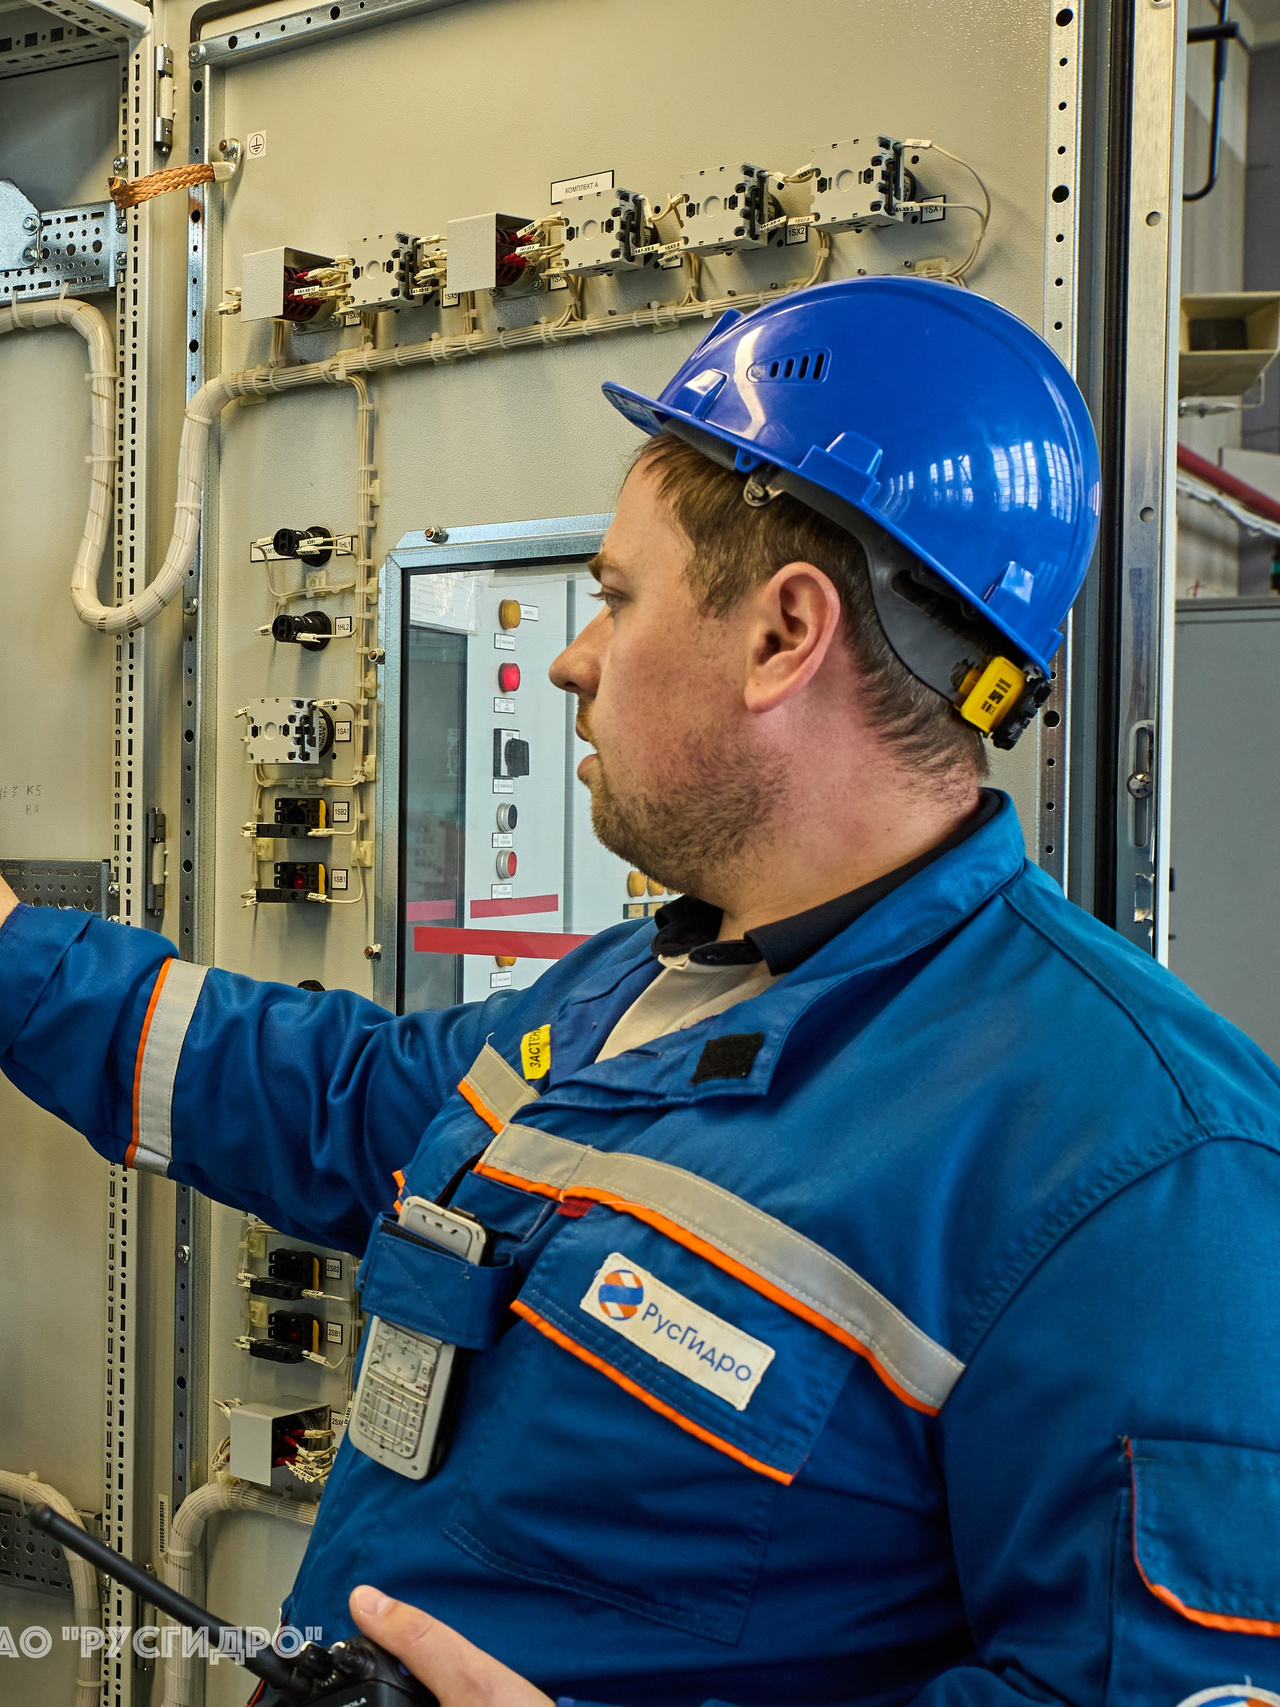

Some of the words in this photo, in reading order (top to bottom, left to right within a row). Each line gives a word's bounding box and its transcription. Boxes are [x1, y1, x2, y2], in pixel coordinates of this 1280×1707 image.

[564, 183, 592, 194] КОМПЛЕКТ
[788, 226, 805, 237] 1SX2
[326, 1264, 340, 1273] 2SB2
[328, 1329, 341, 1338] 2SB1
[642, 1302, 752, 1382] РусГидро
